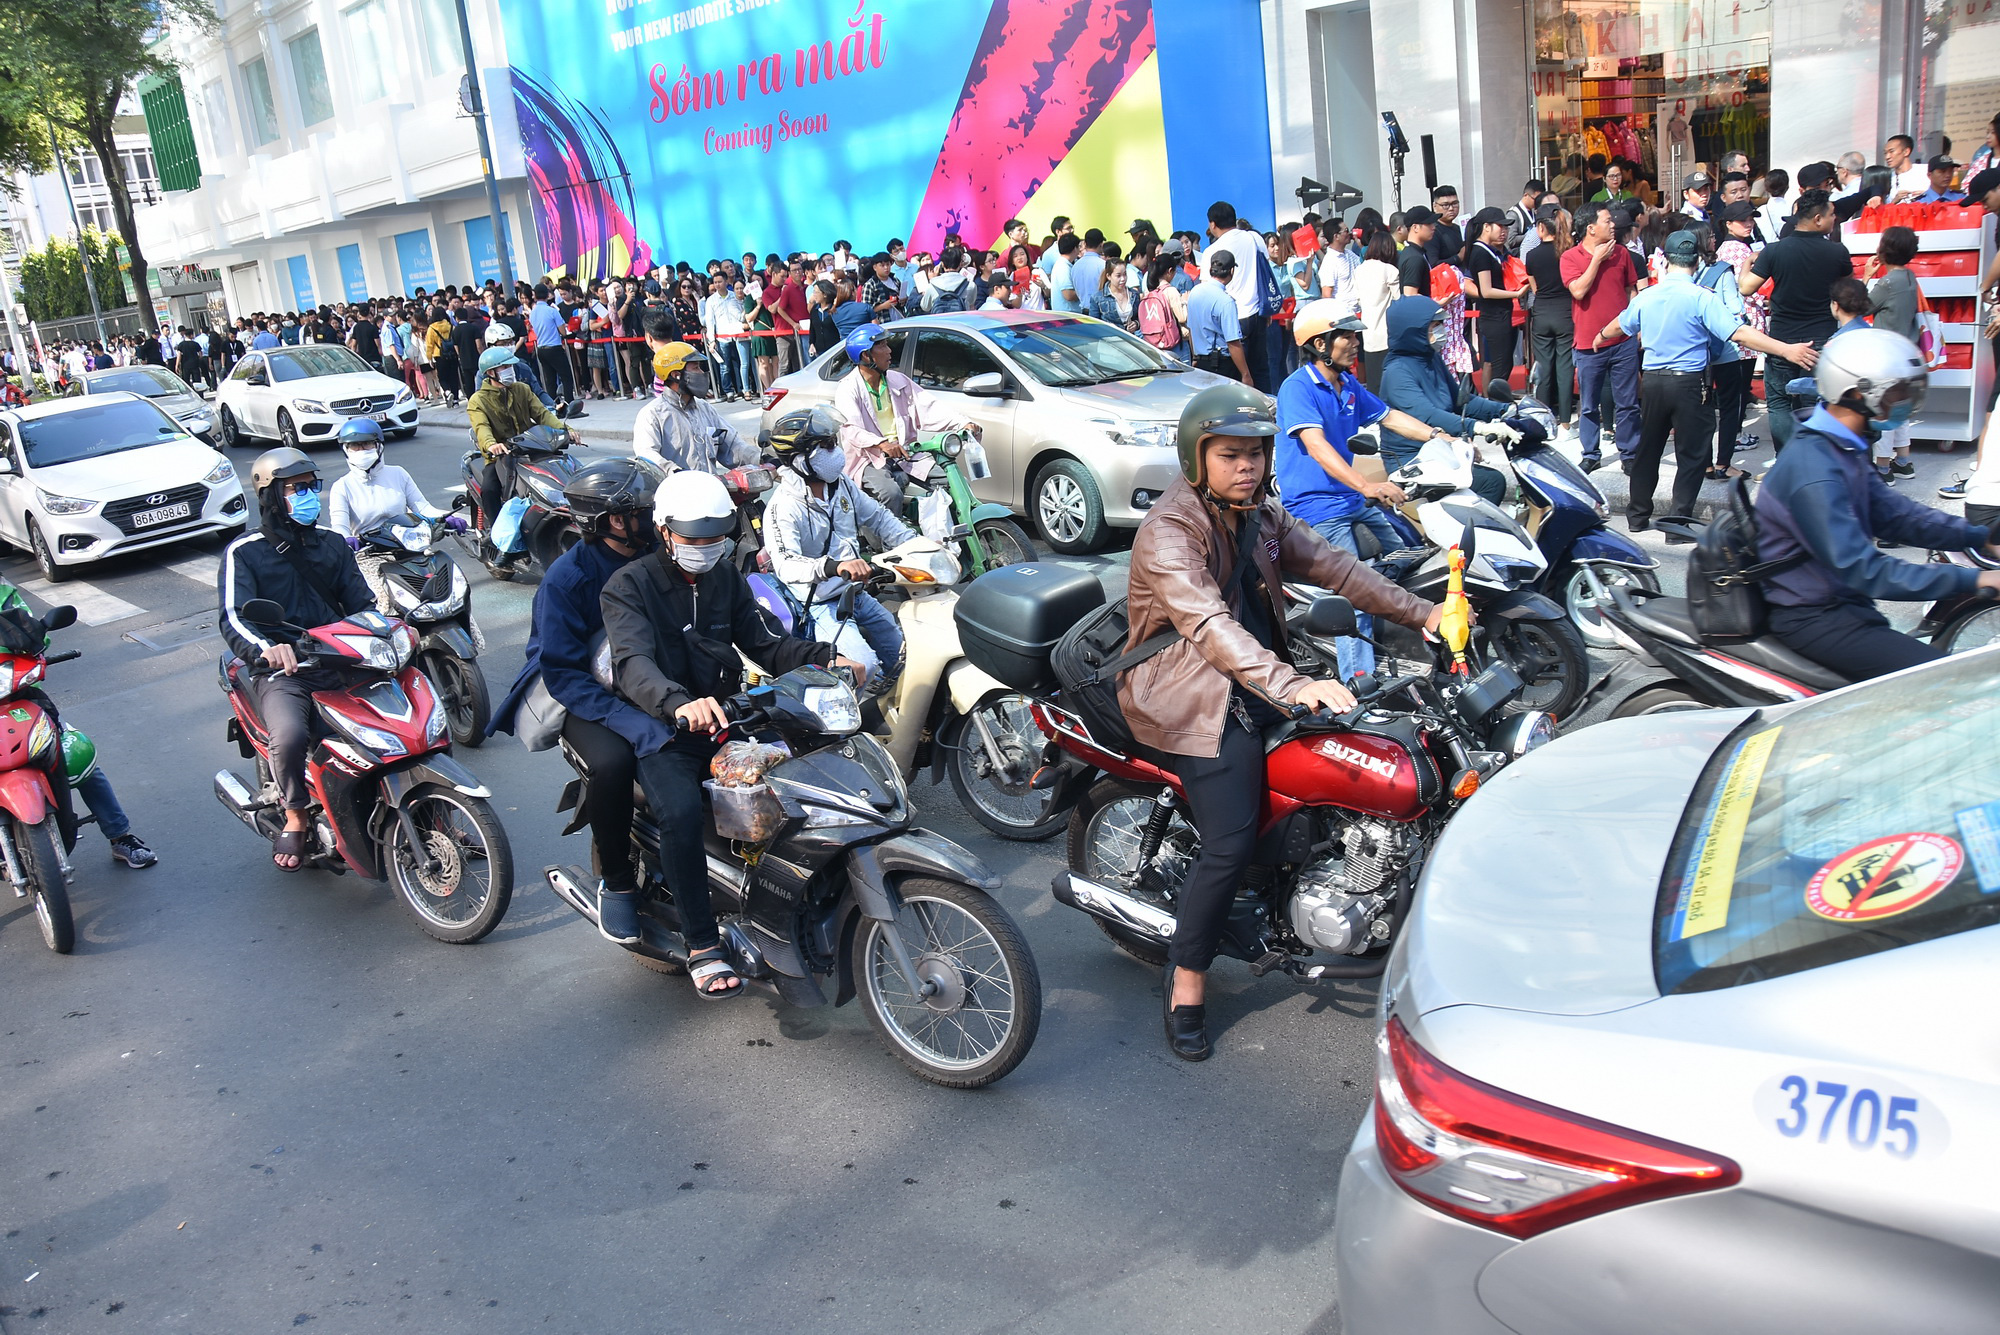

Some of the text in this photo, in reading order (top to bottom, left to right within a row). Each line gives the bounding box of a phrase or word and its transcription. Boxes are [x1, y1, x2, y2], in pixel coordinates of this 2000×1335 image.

[611, 26, 643, 52] YOUR
[644, 16, 672, 42] NEW
[673, 1, 734, 33] FAVORITE
[649, 0, 888, 123] Sớm ra mắt
[704, 110, 830, 155] Coming Soon
[135, 504, 189, 526] 86A-098.49
[1322, 739, 1398, 779] SUZUKI
[758, 876, 792, 901] YAMAHA
[1776, 1074, 1919, 1161] 3705
